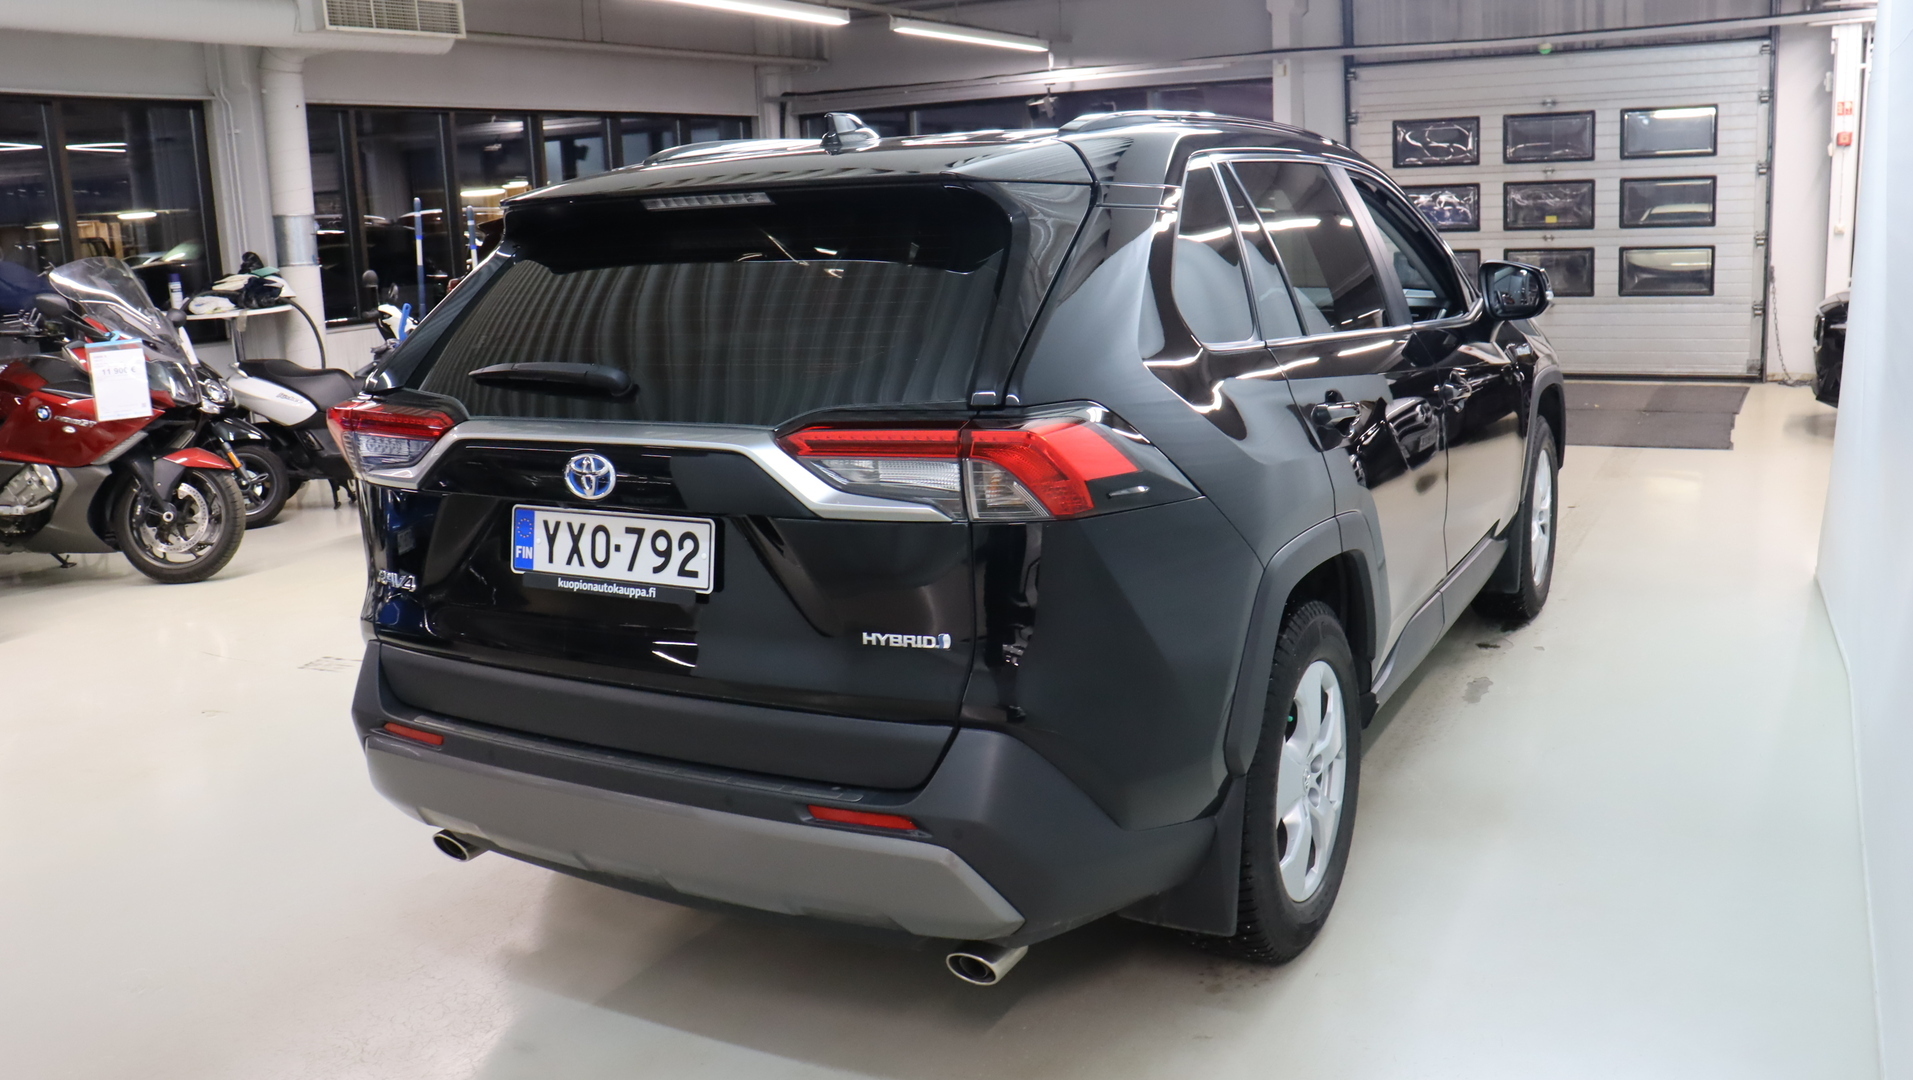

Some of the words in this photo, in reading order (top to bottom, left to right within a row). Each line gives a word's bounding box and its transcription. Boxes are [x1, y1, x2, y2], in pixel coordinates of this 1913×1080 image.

[515, 545, 533, 560] FIN
[543, 519, 700, 579] YXO-792
[557, 577, 657, 599] kuopionautokauppa.fi
[862, 631, 937, 649] HYBRID
